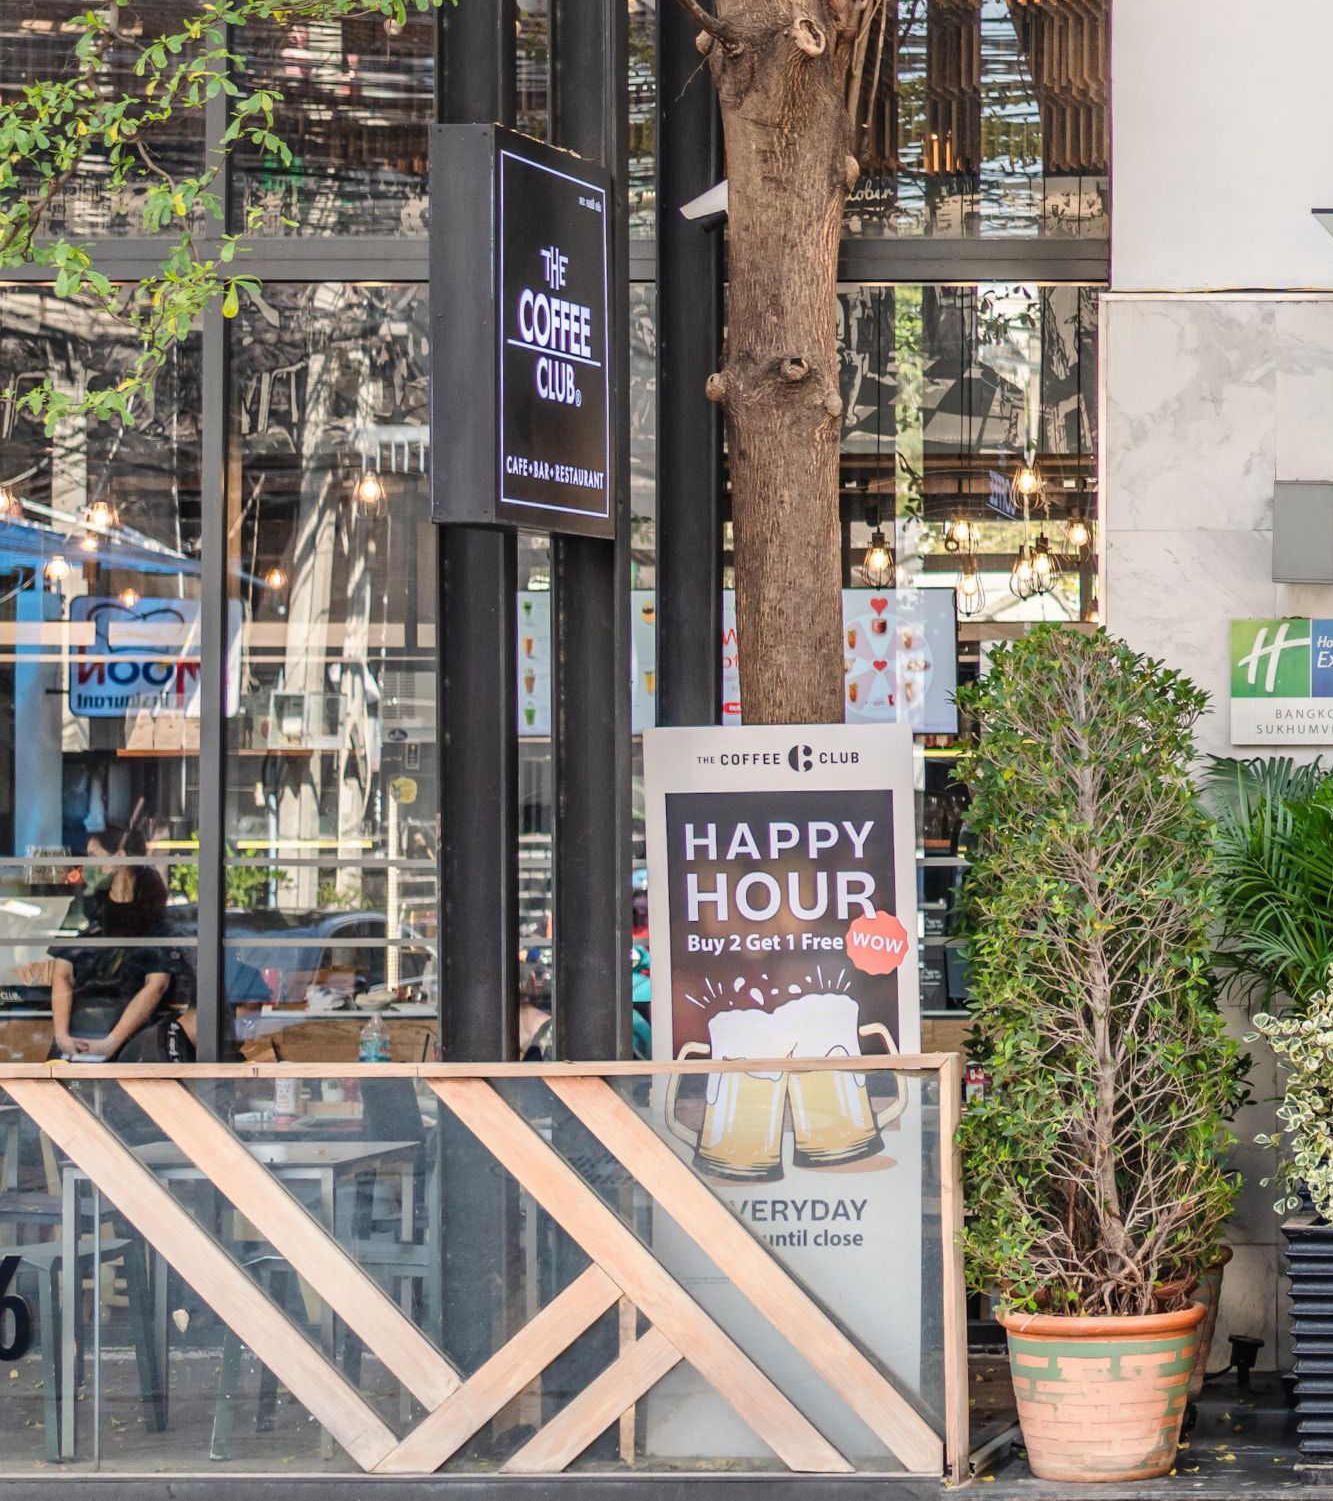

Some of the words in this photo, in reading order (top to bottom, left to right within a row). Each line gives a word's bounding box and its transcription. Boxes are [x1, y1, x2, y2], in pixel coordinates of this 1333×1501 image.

[540, 246, 569, 291] THE
[519, 288, 592, 358] COFFEE
[536, 356, 576, 405] CLUB
[507, 455, 528, 478] CAFE
[533, 460, 550, 481] BAR
[555, 464, 604, 490] RESTAURANT
[697, 756, 715, 764] THE
[720, 753, 781, 766] COFFEE
[819, 752, 859, 765] CLUB
[684, 820, 875, 861] HAPPY
[686, 871, 877, 922] HOUR
[688, 934, 725, 956] Buy
[729, 934, 741, 951] 2
[746, 934, 780, 951] Get
[786, 934, 795, 950] 1
[802, 933, 844, 950] Free
[852, 931, 903, 954] WOW
[813, 1230, 864, 1247] close
